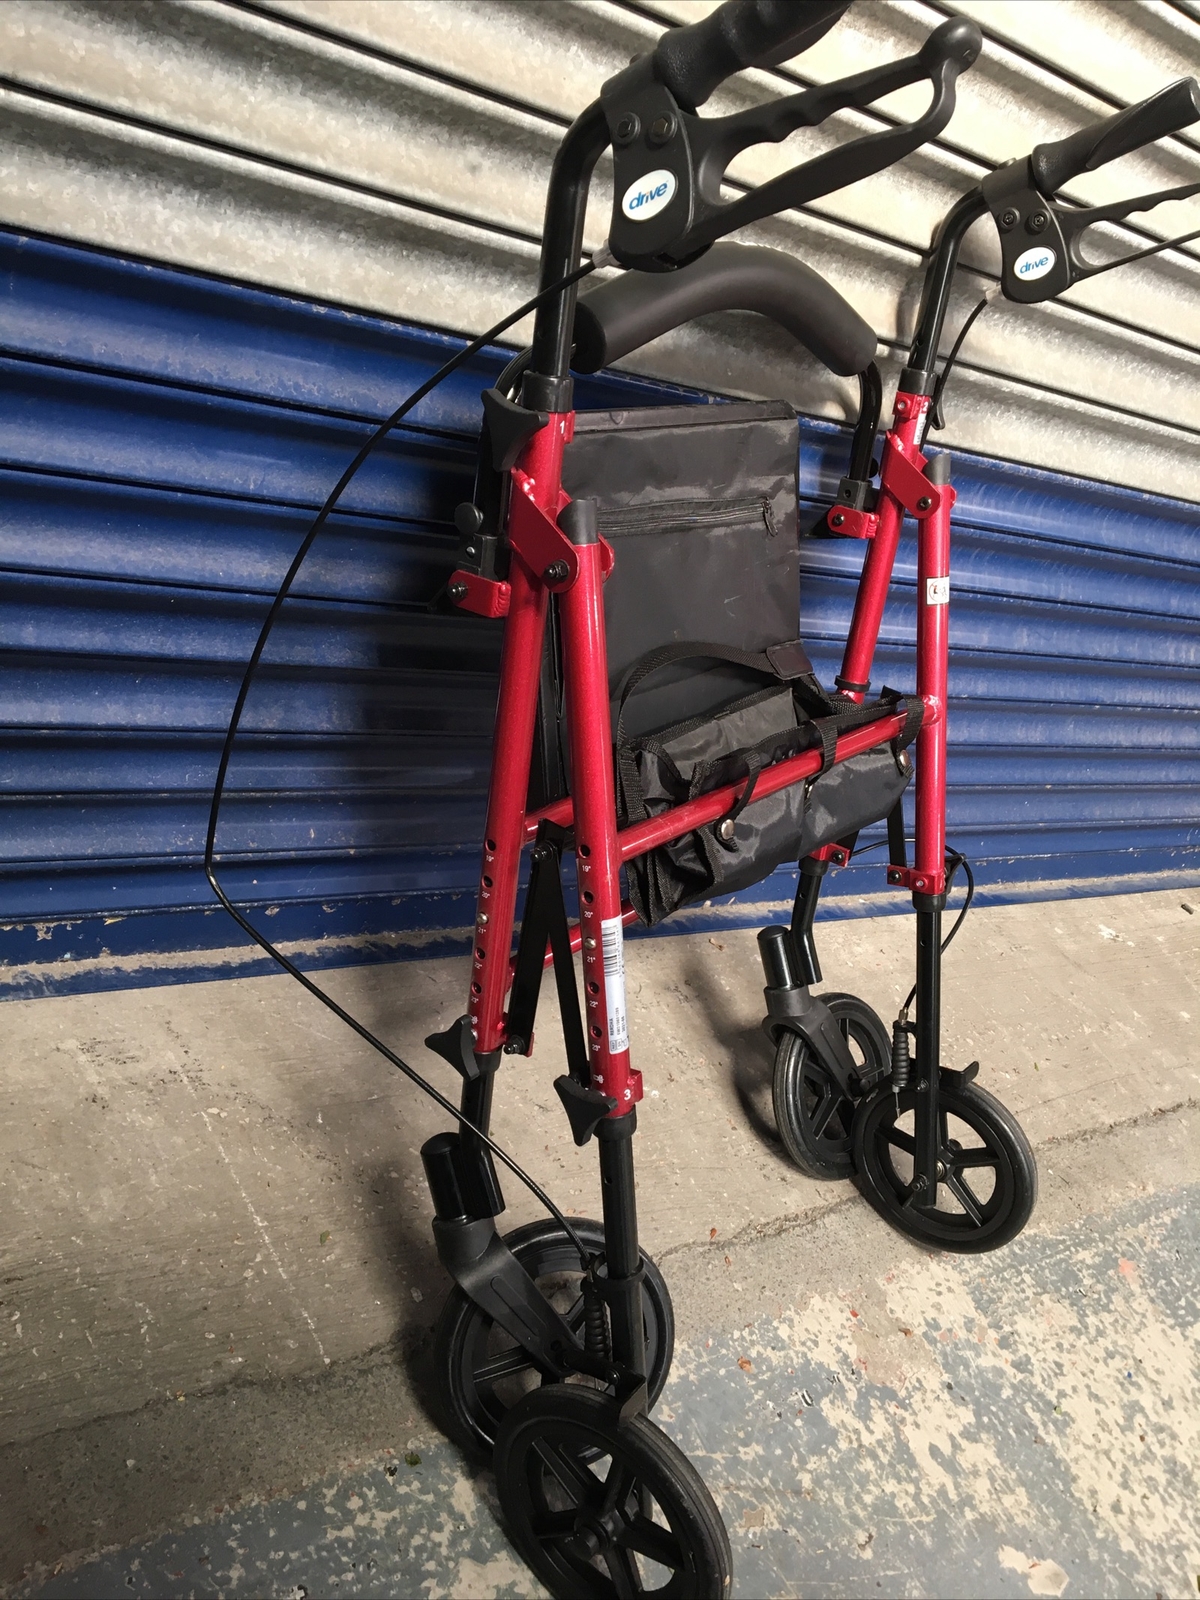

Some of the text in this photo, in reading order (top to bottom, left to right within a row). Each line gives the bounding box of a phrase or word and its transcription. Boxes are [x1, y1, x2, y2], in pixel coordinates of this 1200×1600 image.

[628, 183, 668, 210] drive
[1019, 256, 1049, 274] drive
[922, 401, 929, 411] 2
[559, 420, 565, 434] 1
[582, 865, 591, 873] 19"
[584, 911, 594, 919] 20"
[587, 956, 596, 964] 21"
[623, 1088, 632, 1101] 3
